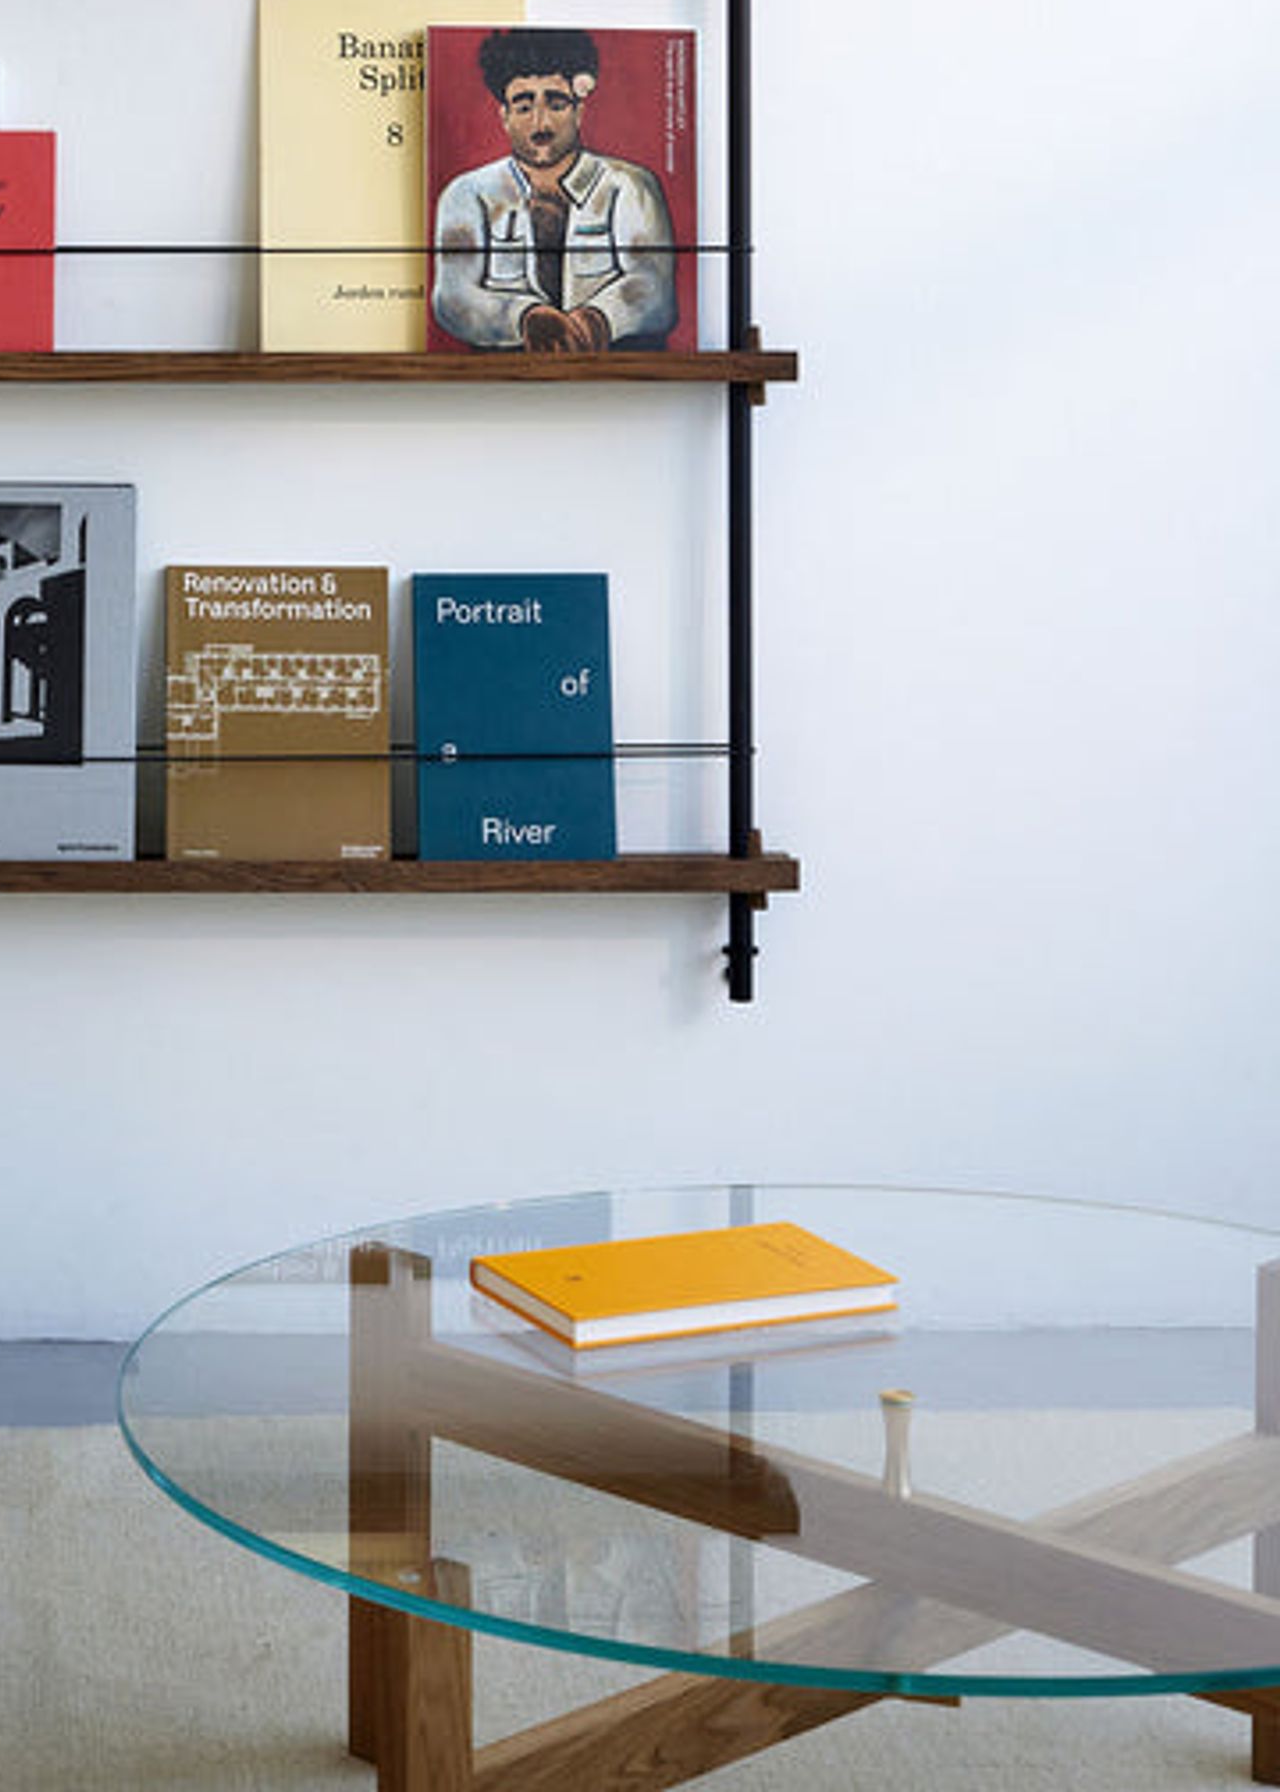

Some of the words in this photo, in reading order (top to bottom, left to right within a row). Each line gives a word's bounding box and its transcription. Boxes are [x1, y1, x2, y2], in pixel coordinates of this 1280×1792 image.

[386, 125, 404, 146] 8
[183, 572, 316, 595] Renovation
[321, 572, 337, 595] &
[184, 597, 372, 621] Transformation
[436, 596, 543, 624] Portrait
[560, 667, 591, 696] of
[482, 817, 558, 845] River
